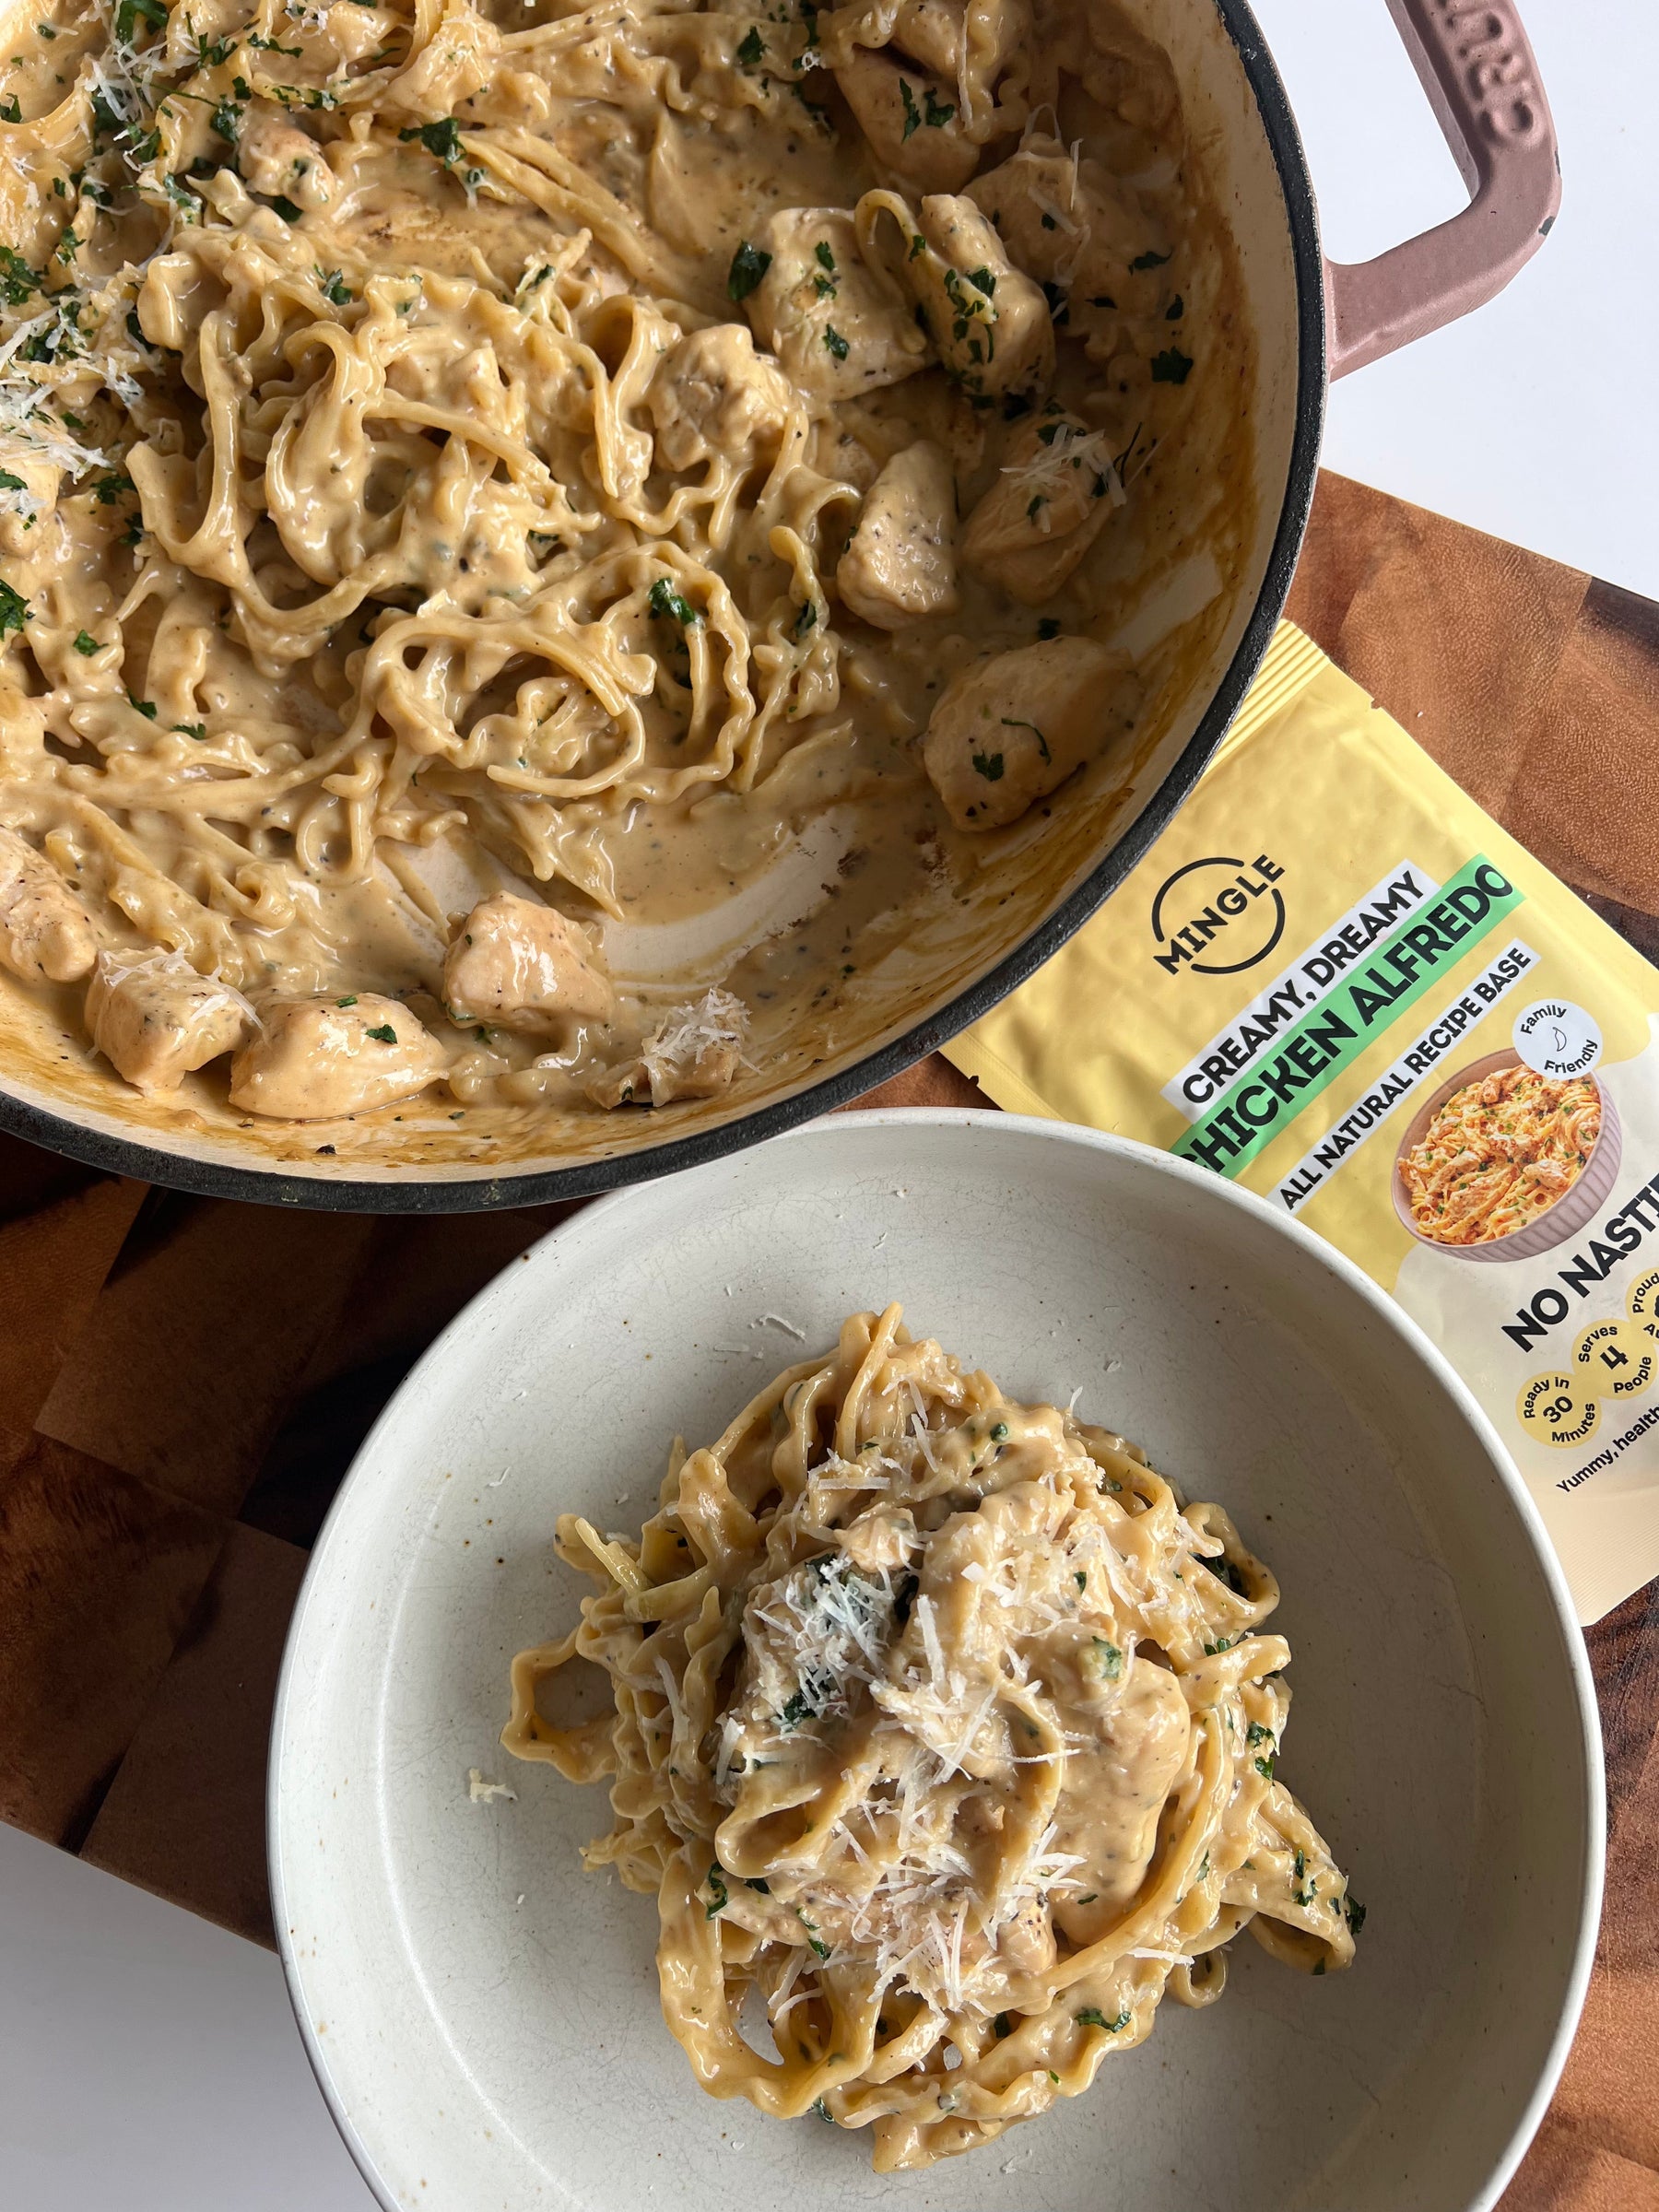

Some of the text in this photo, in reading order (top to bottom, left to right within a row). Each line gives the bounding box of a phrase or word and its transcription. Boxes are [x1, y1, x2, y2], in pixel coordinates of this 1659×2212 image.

[1152, 854, 1286, 975] MINGLE
[1348, 864, 1514, 1026] ALFREDO
[1182, 870, 1425, 1104] CREAMY, DREAMY
[1520, 1004, 1568, 1035] Family
[1544, 1038, 1599, 1075] Friendly
[1279, 947, 1532, 1210] ALL NATURAL RECIPE BASE
[1500, 1172, 1659, 1353] NO NASTI
[1578, 1324, 1618, 1363] Serves
[1599, 1345, 1629, 1370] 4
[1613, 1355, 1652, 1394] People
[1524, 1376, 1570, 1419] Ready in
[1543, 1395, 1573, 1423] 30
[1551, 1402, 1595, 1442] Minutes
[1556, 1448, 1618, 1493] Yummy,
